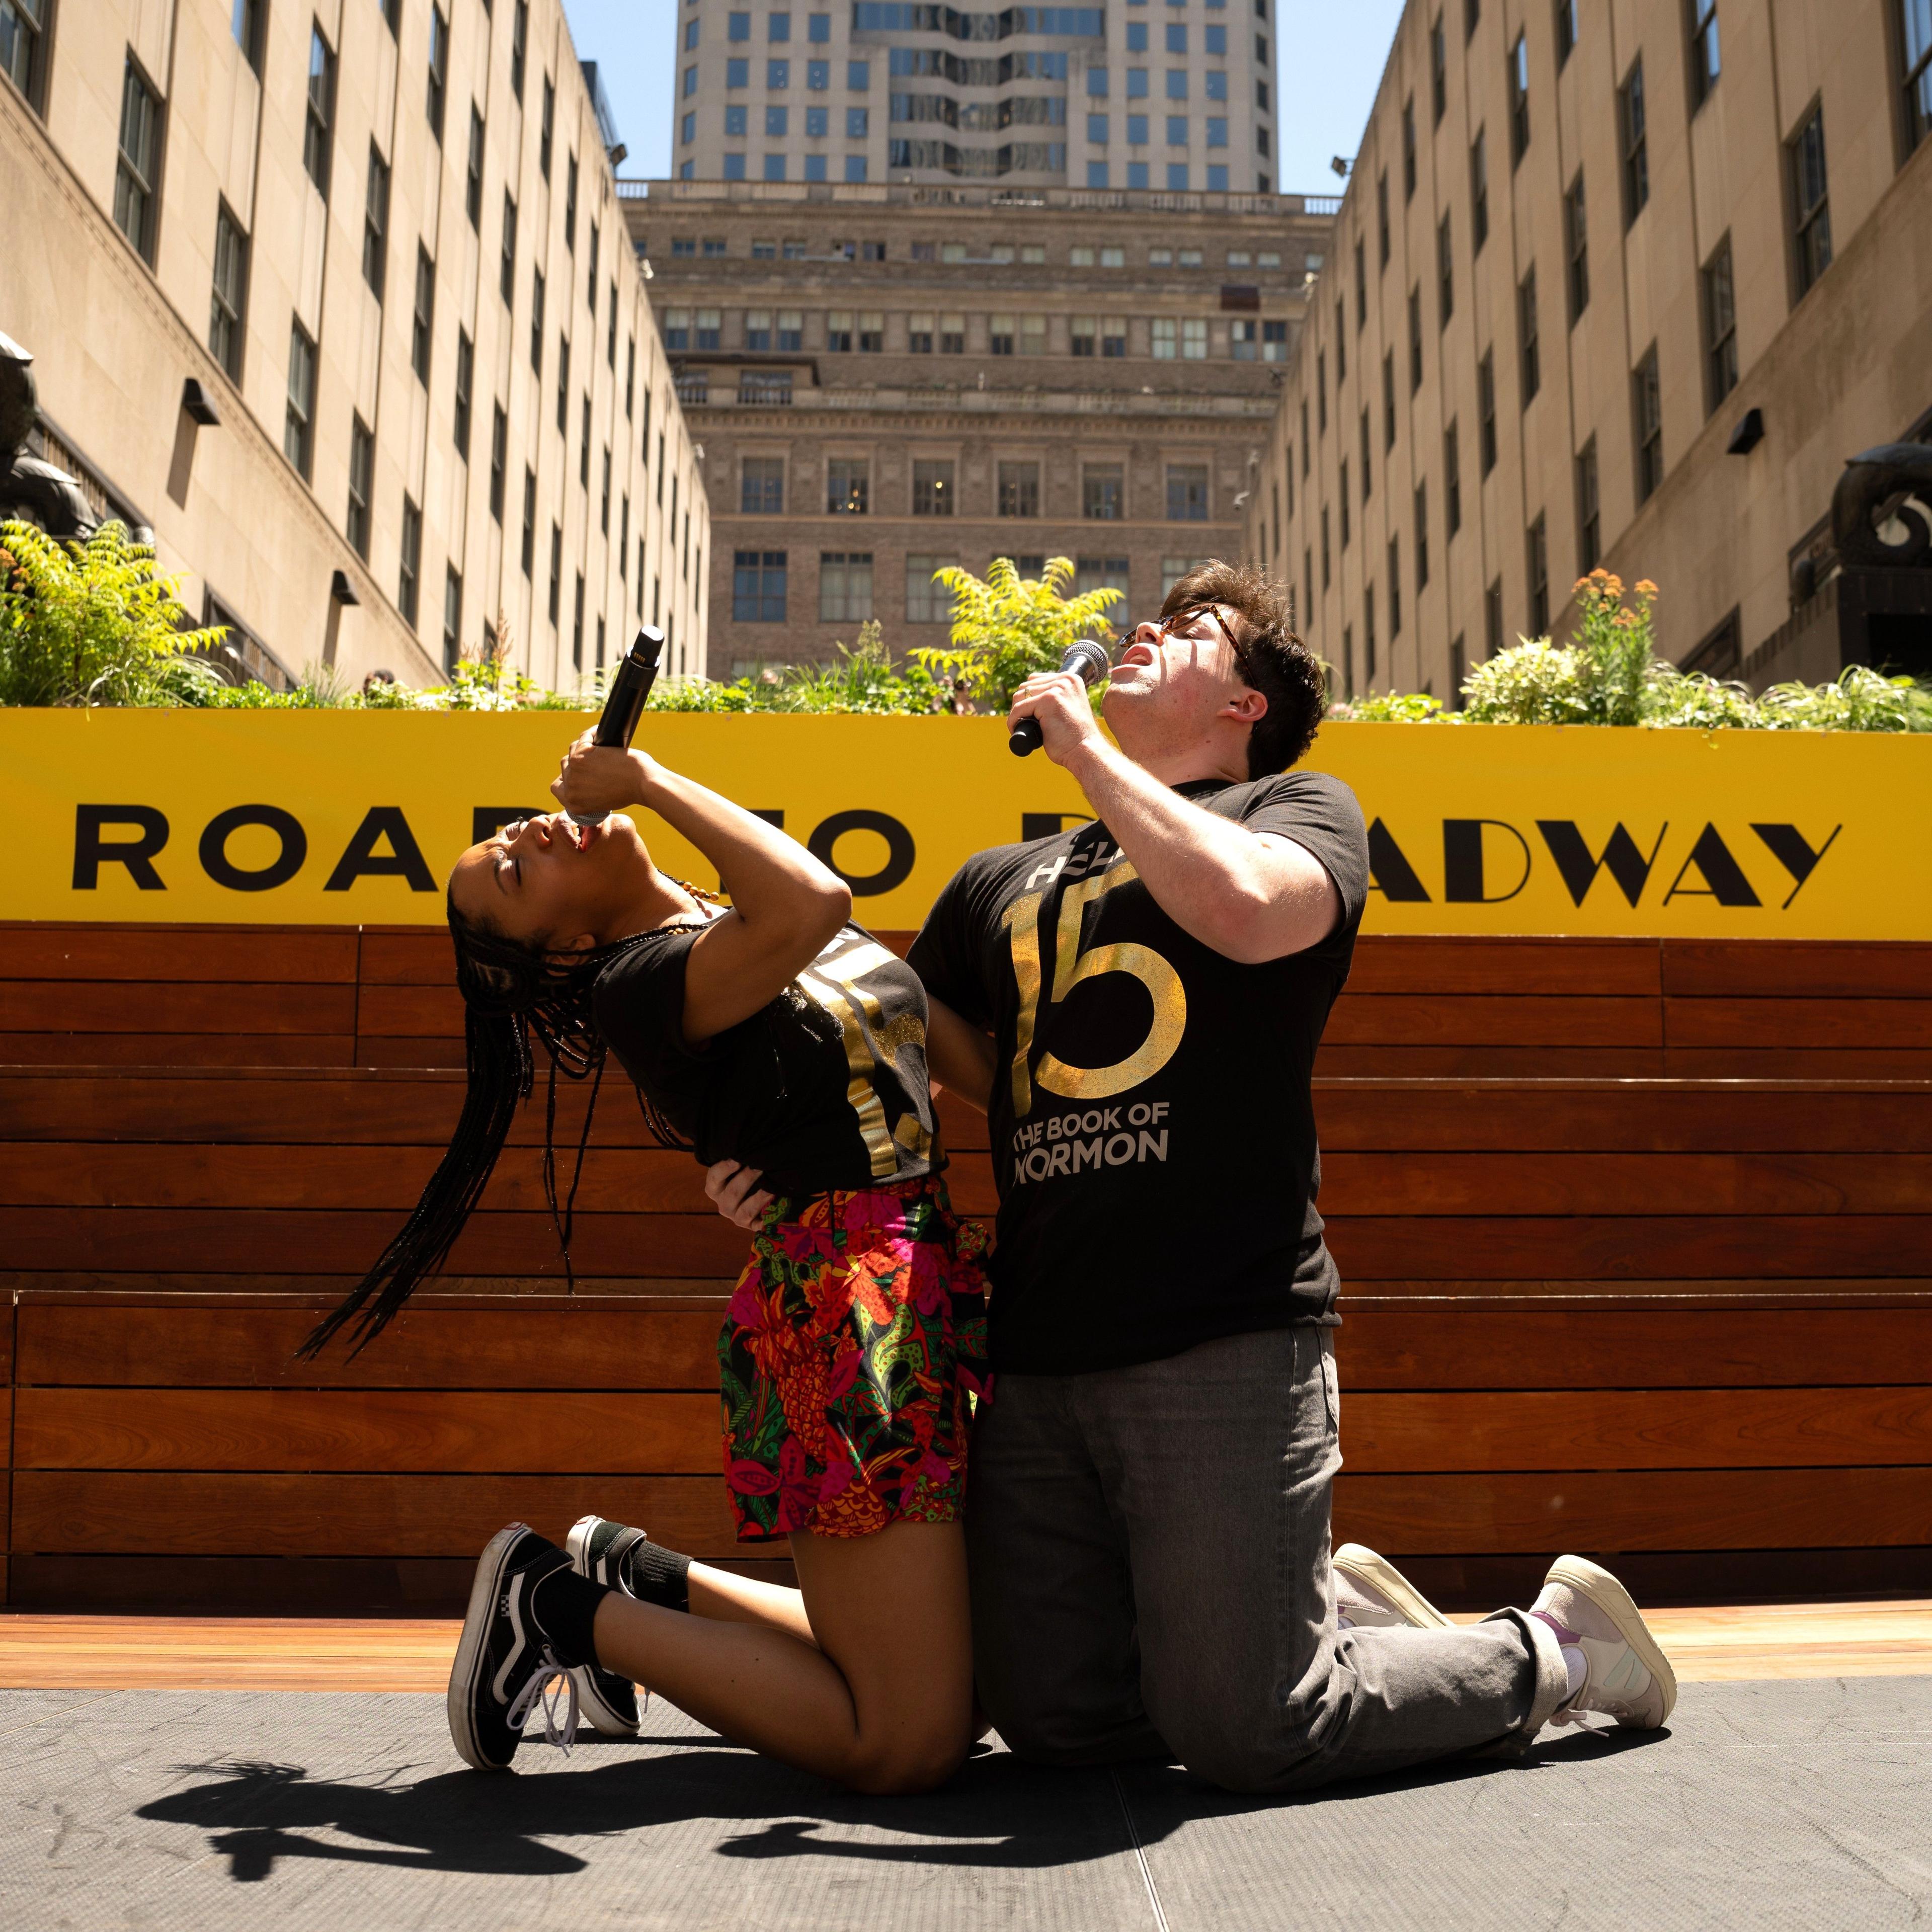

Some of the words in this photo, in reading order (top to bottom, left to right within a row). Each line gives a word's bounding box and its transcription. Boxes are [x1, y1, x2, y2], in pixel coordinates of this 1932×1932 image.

[719, 809, 916, 898] O
[1002, 860, 1187, 1118] 15
[1046, 1106, 1122, 1141] BOOK
[1128, 1102, 1170, 1126] OF
